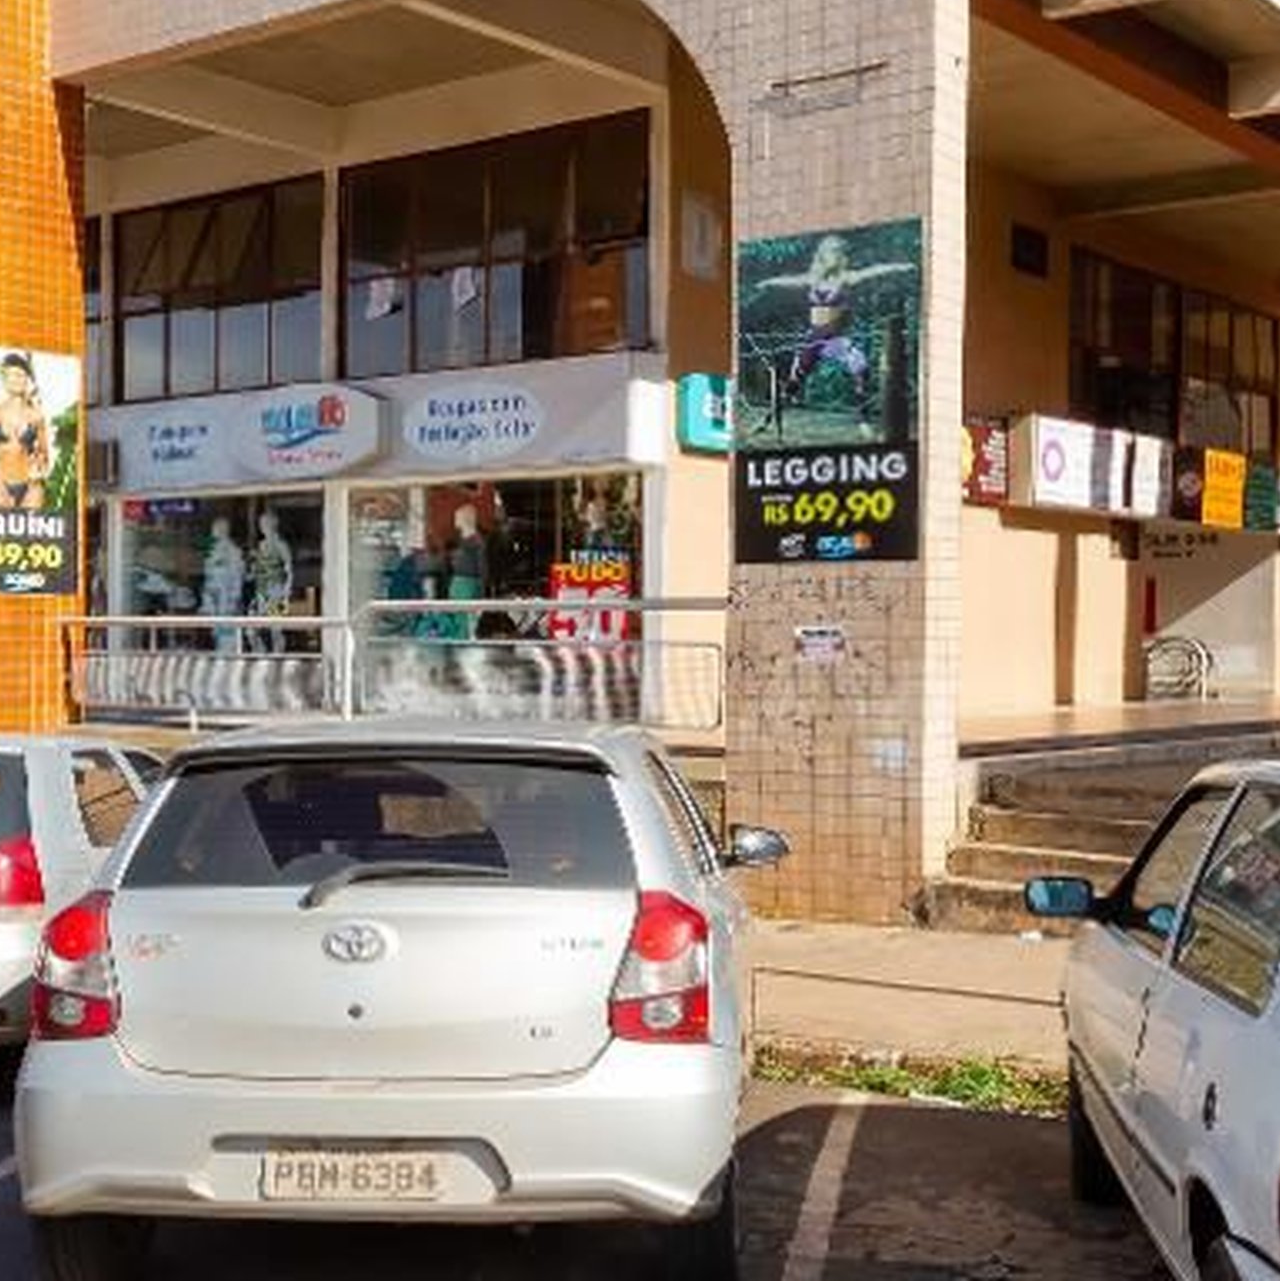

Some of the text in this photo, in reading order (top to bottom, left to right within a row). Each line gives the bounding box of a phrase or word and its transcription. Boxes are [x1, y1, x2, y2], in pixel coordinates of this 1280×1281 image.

[747, 452, 908, 487] LEGGING
[763, 489, 895, 527] R$ 69,90
